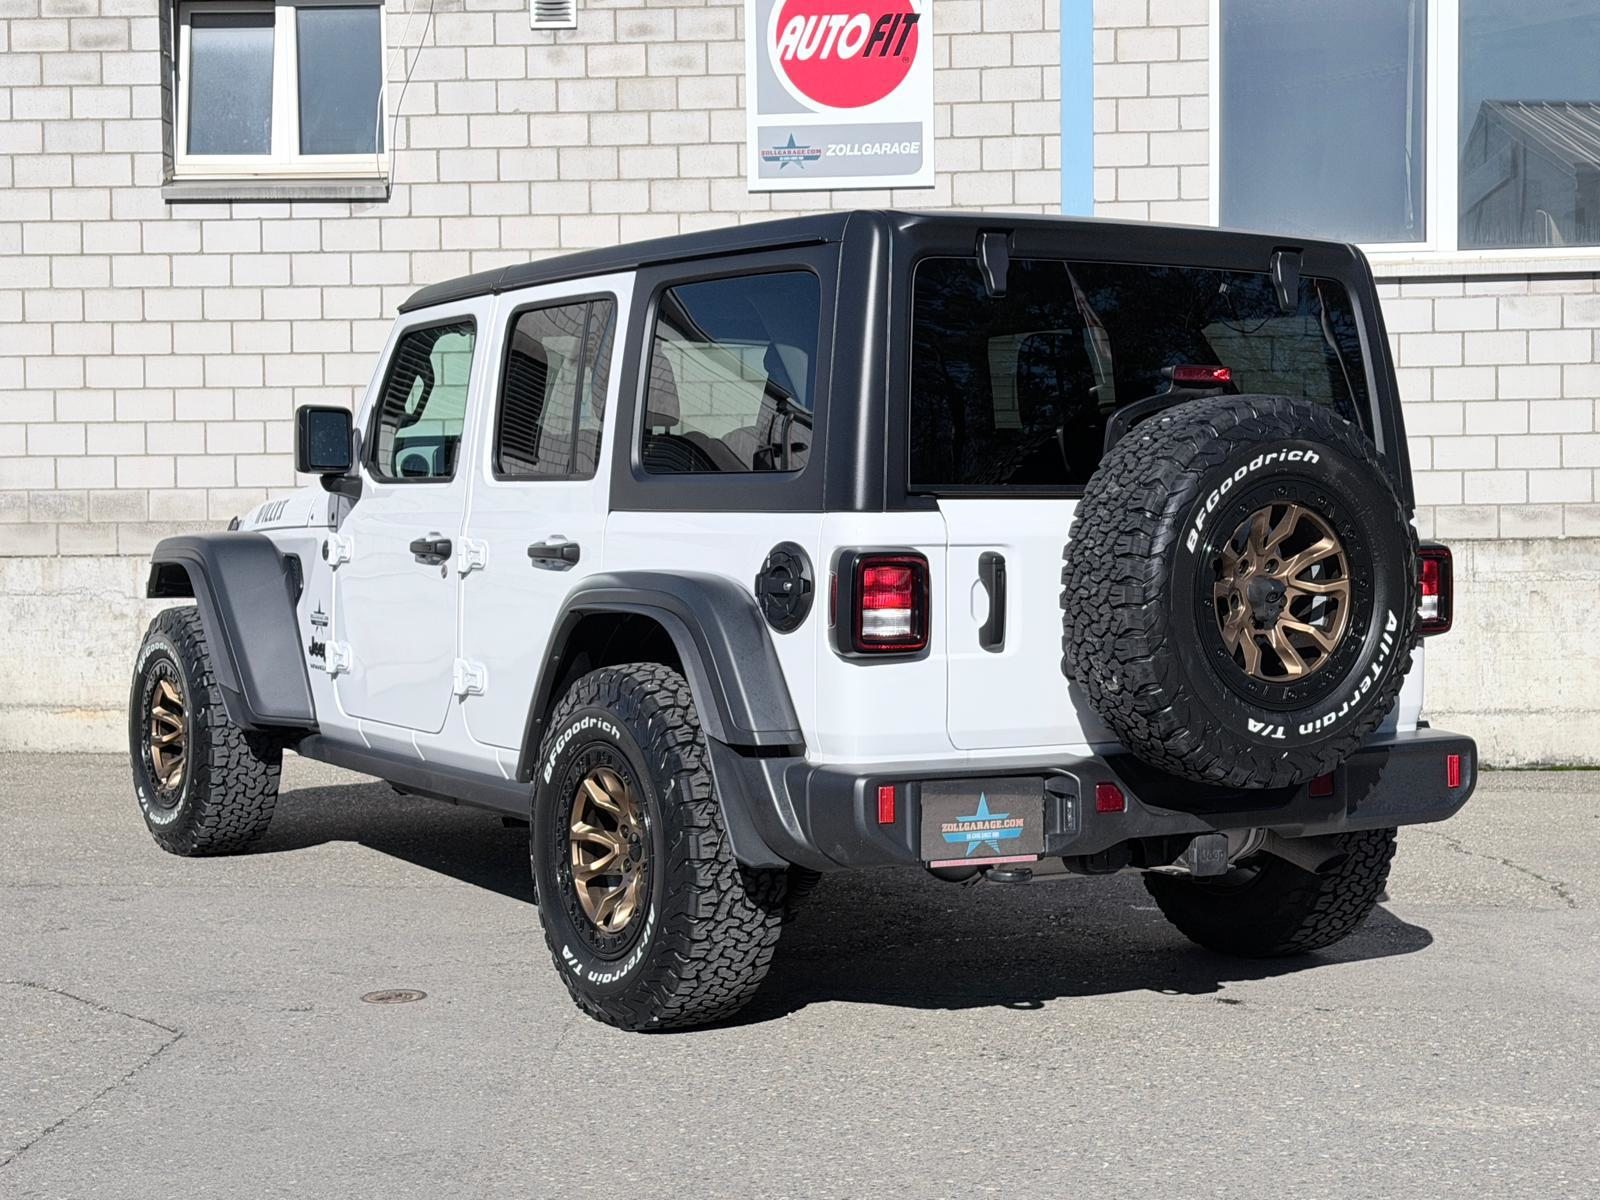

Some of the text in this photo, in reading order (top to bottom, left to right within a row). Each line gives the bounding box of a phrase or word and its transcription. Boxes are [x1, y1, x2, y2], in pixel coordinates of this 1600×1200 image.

[826, 141, 920, 157] ZOLLGARAGE
[1186, 448, 1320, 554] BFGoodrich
[1247, 608, 1398, 740] All-Terrain T/A
[544, 715, 621, 785] BFGoodrich
[942, 818, 1024, 832] ZOLLGARAGE.COM
[562, 902, 656, 986] All-Terrain T/A
